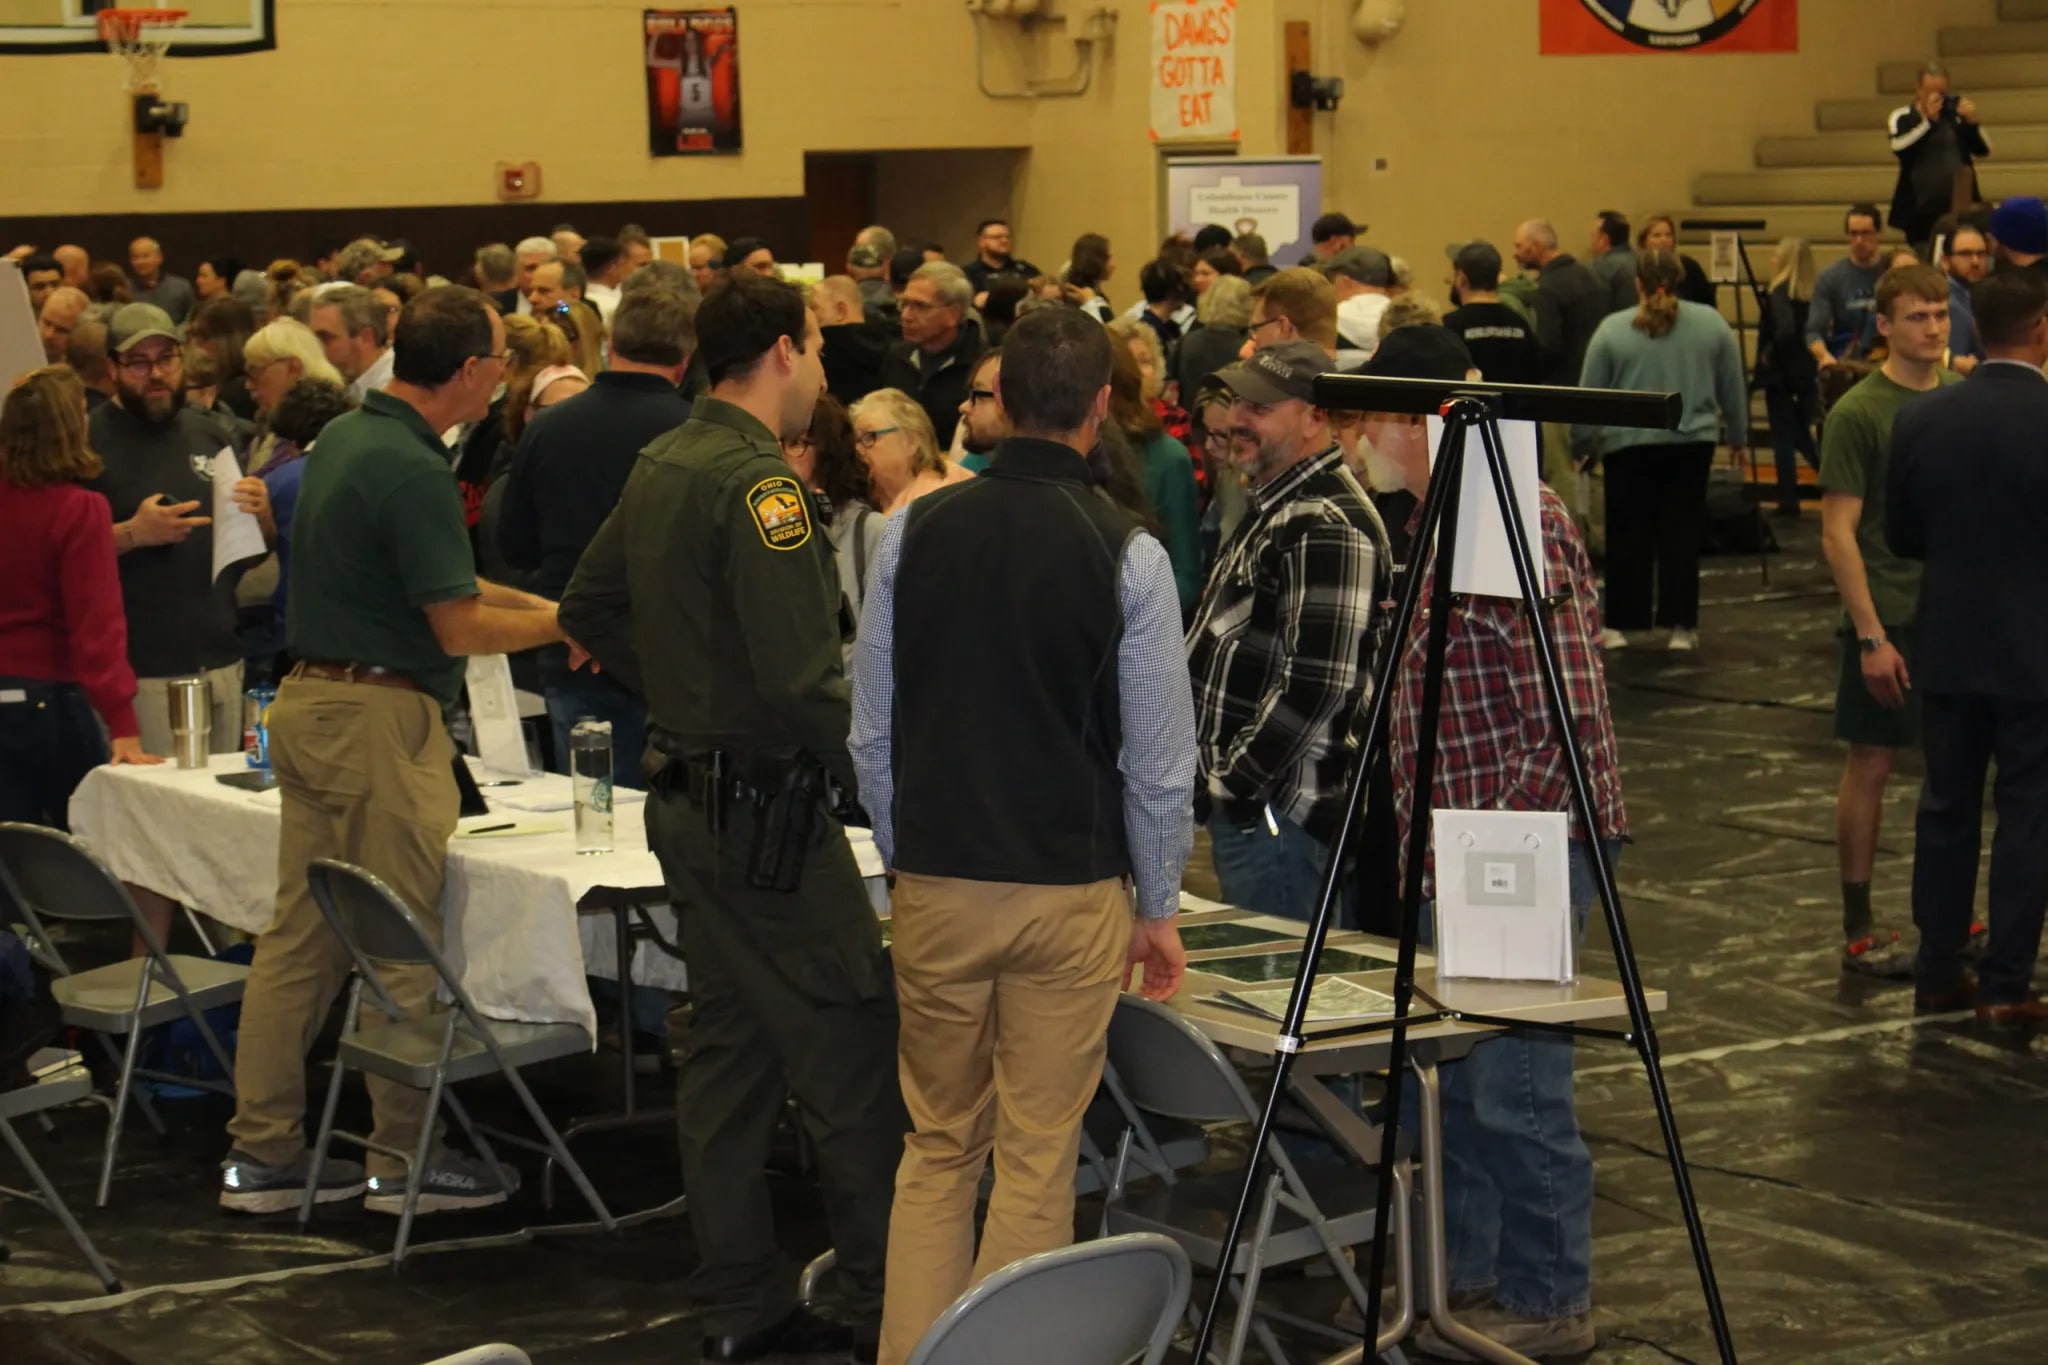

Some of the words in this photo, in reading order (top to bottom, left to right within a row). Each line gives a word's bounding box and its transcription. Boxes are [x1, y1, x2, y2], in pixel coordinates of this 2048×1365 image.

[1164, 6, 1231, 51] DAWGS
[1159, 55, 1227, 88] GOTTA
[1179, 91, 1214, 127] EAT
[760, 480, 783, 491] OHIO
[770, 526, 807, 543] WILDLIFE
[429, 1169, 475, 1190] HOKA
